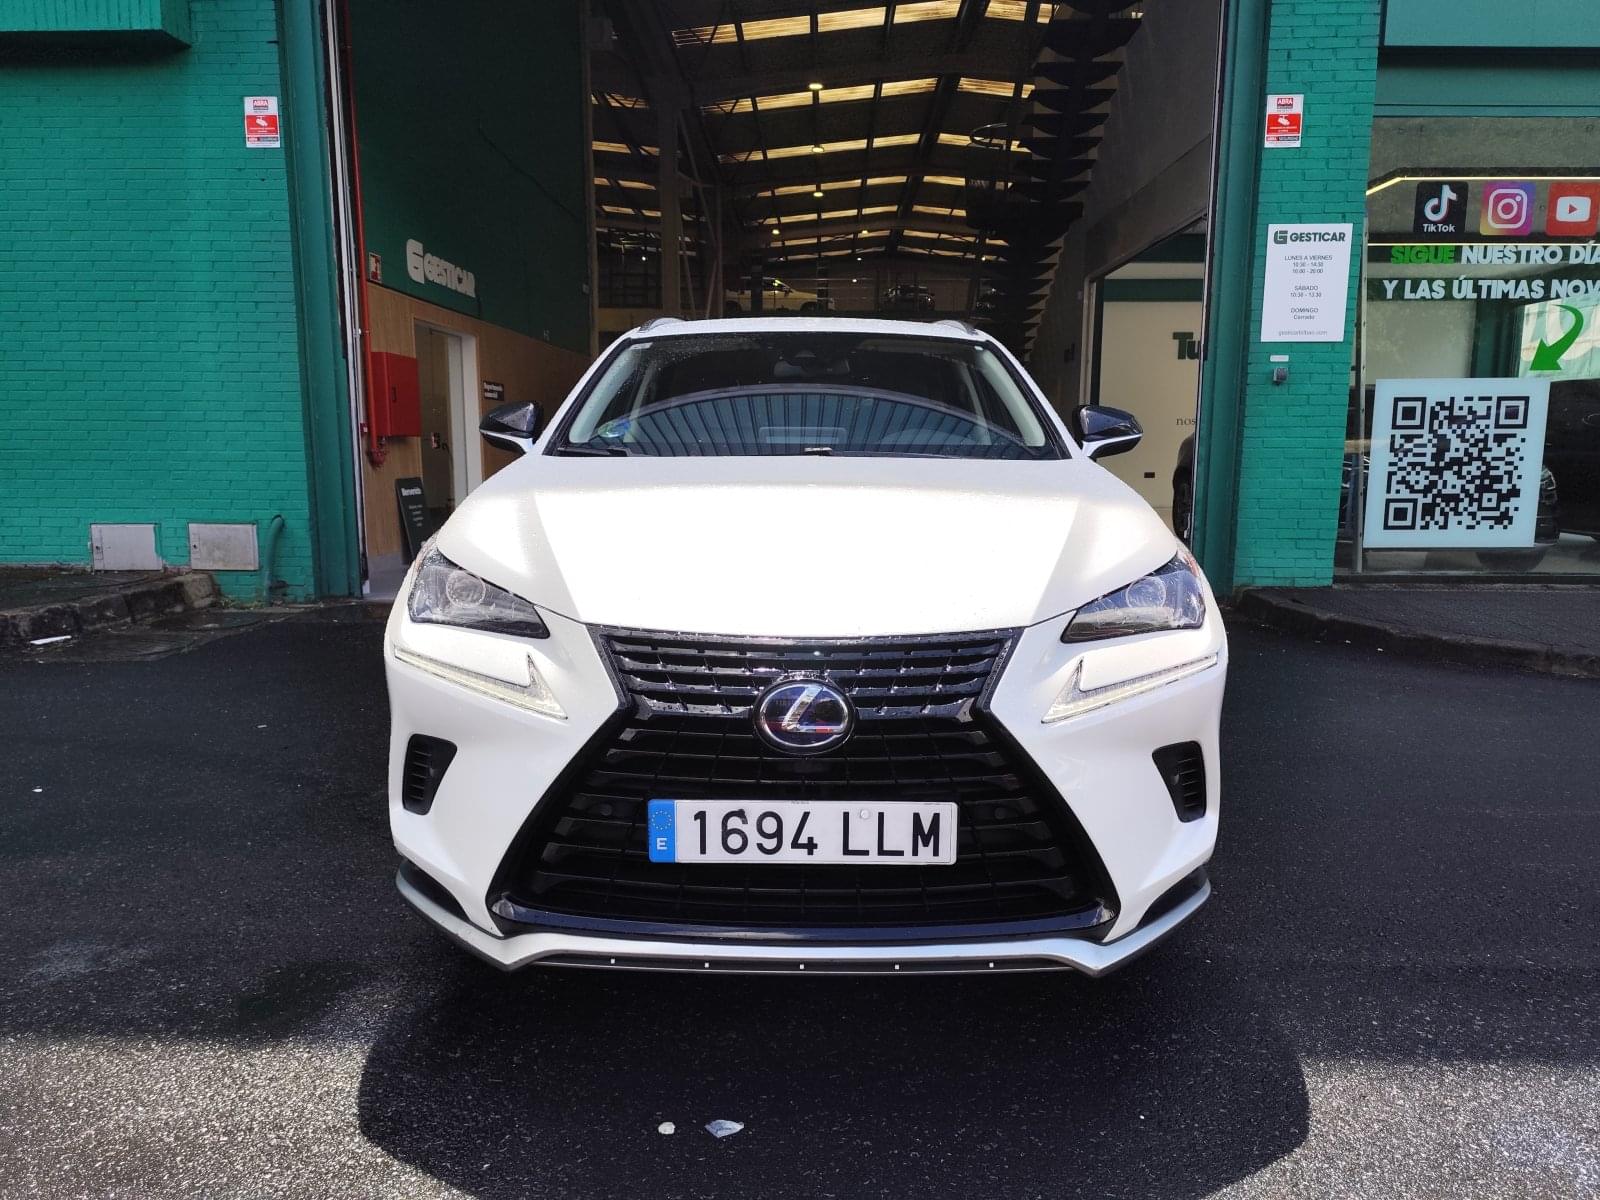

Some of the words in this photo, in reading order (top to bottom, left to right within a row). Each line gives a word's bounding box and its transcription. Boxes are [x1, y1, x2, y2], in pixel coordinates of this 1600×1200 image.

[1422, 223, 1456, 233] TikTok
[1289, 232, 1346, 242] GESTICAR
[1391, 245, 1456, 265] SIGUE
[1461, 245, 1563, 265] NUESTRO
[1383, 280, 1399, 300] Y
[1404, 280, 1446, 300] LAS
[1452, 274, 1545, 300] ÚLTIMAS
[693, 808, 819, 856] 1694
[842, 811, 941, 857] LLM
[656, 837, 668, 850] E
